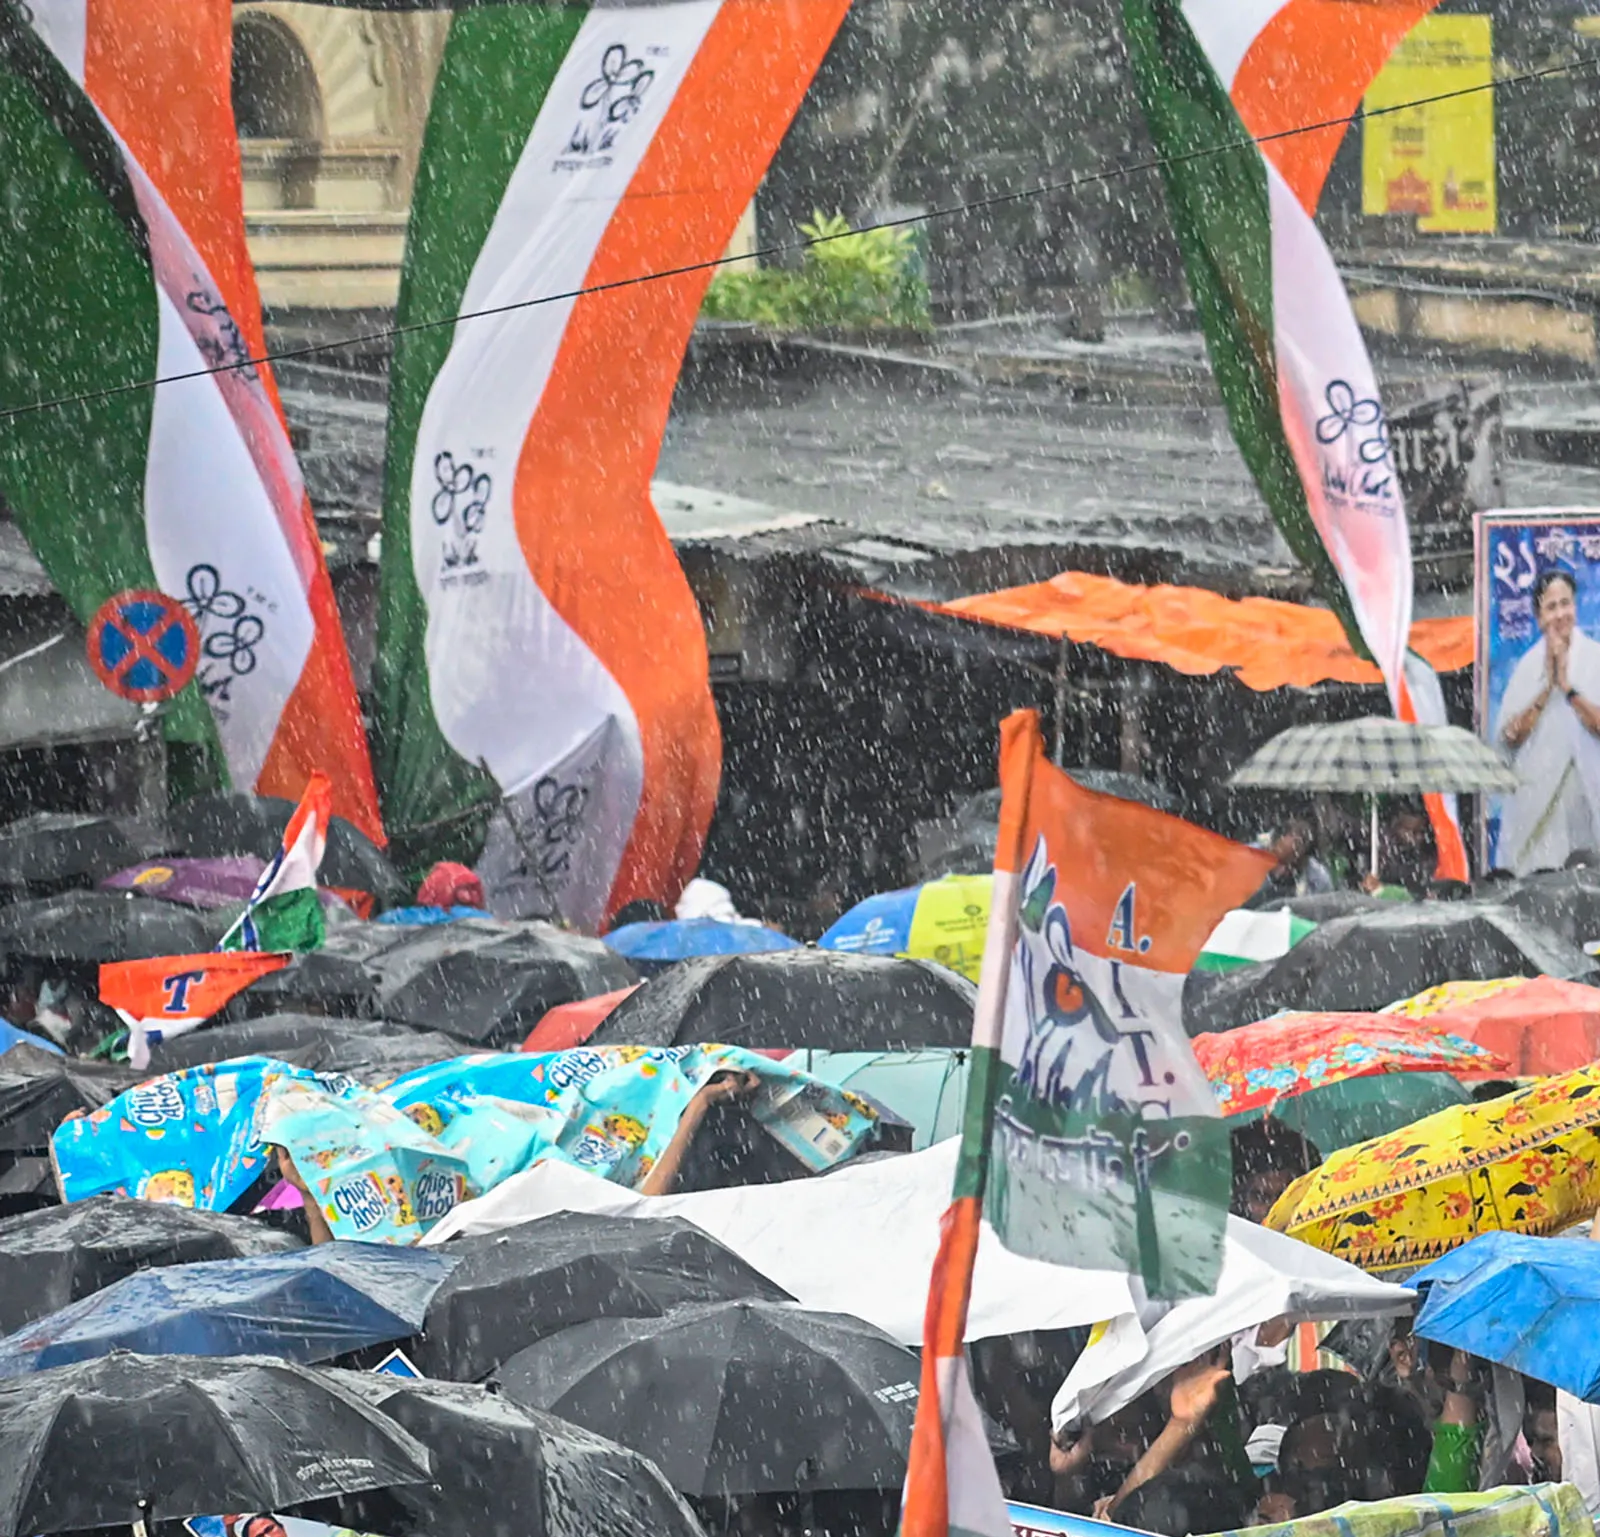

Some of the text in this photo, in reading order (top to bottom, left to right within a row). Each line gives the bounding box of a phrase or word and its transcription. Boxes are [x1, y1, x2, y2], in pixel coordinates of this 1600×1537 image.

[1493, 541, 1537, 593] ২১
[162, 971, 205, 1014] T
[551, 1049, 590, 1088] Chips
[334, 1177, 372, 1215] Chips
[416, 1172, 454, 1200] Chips
